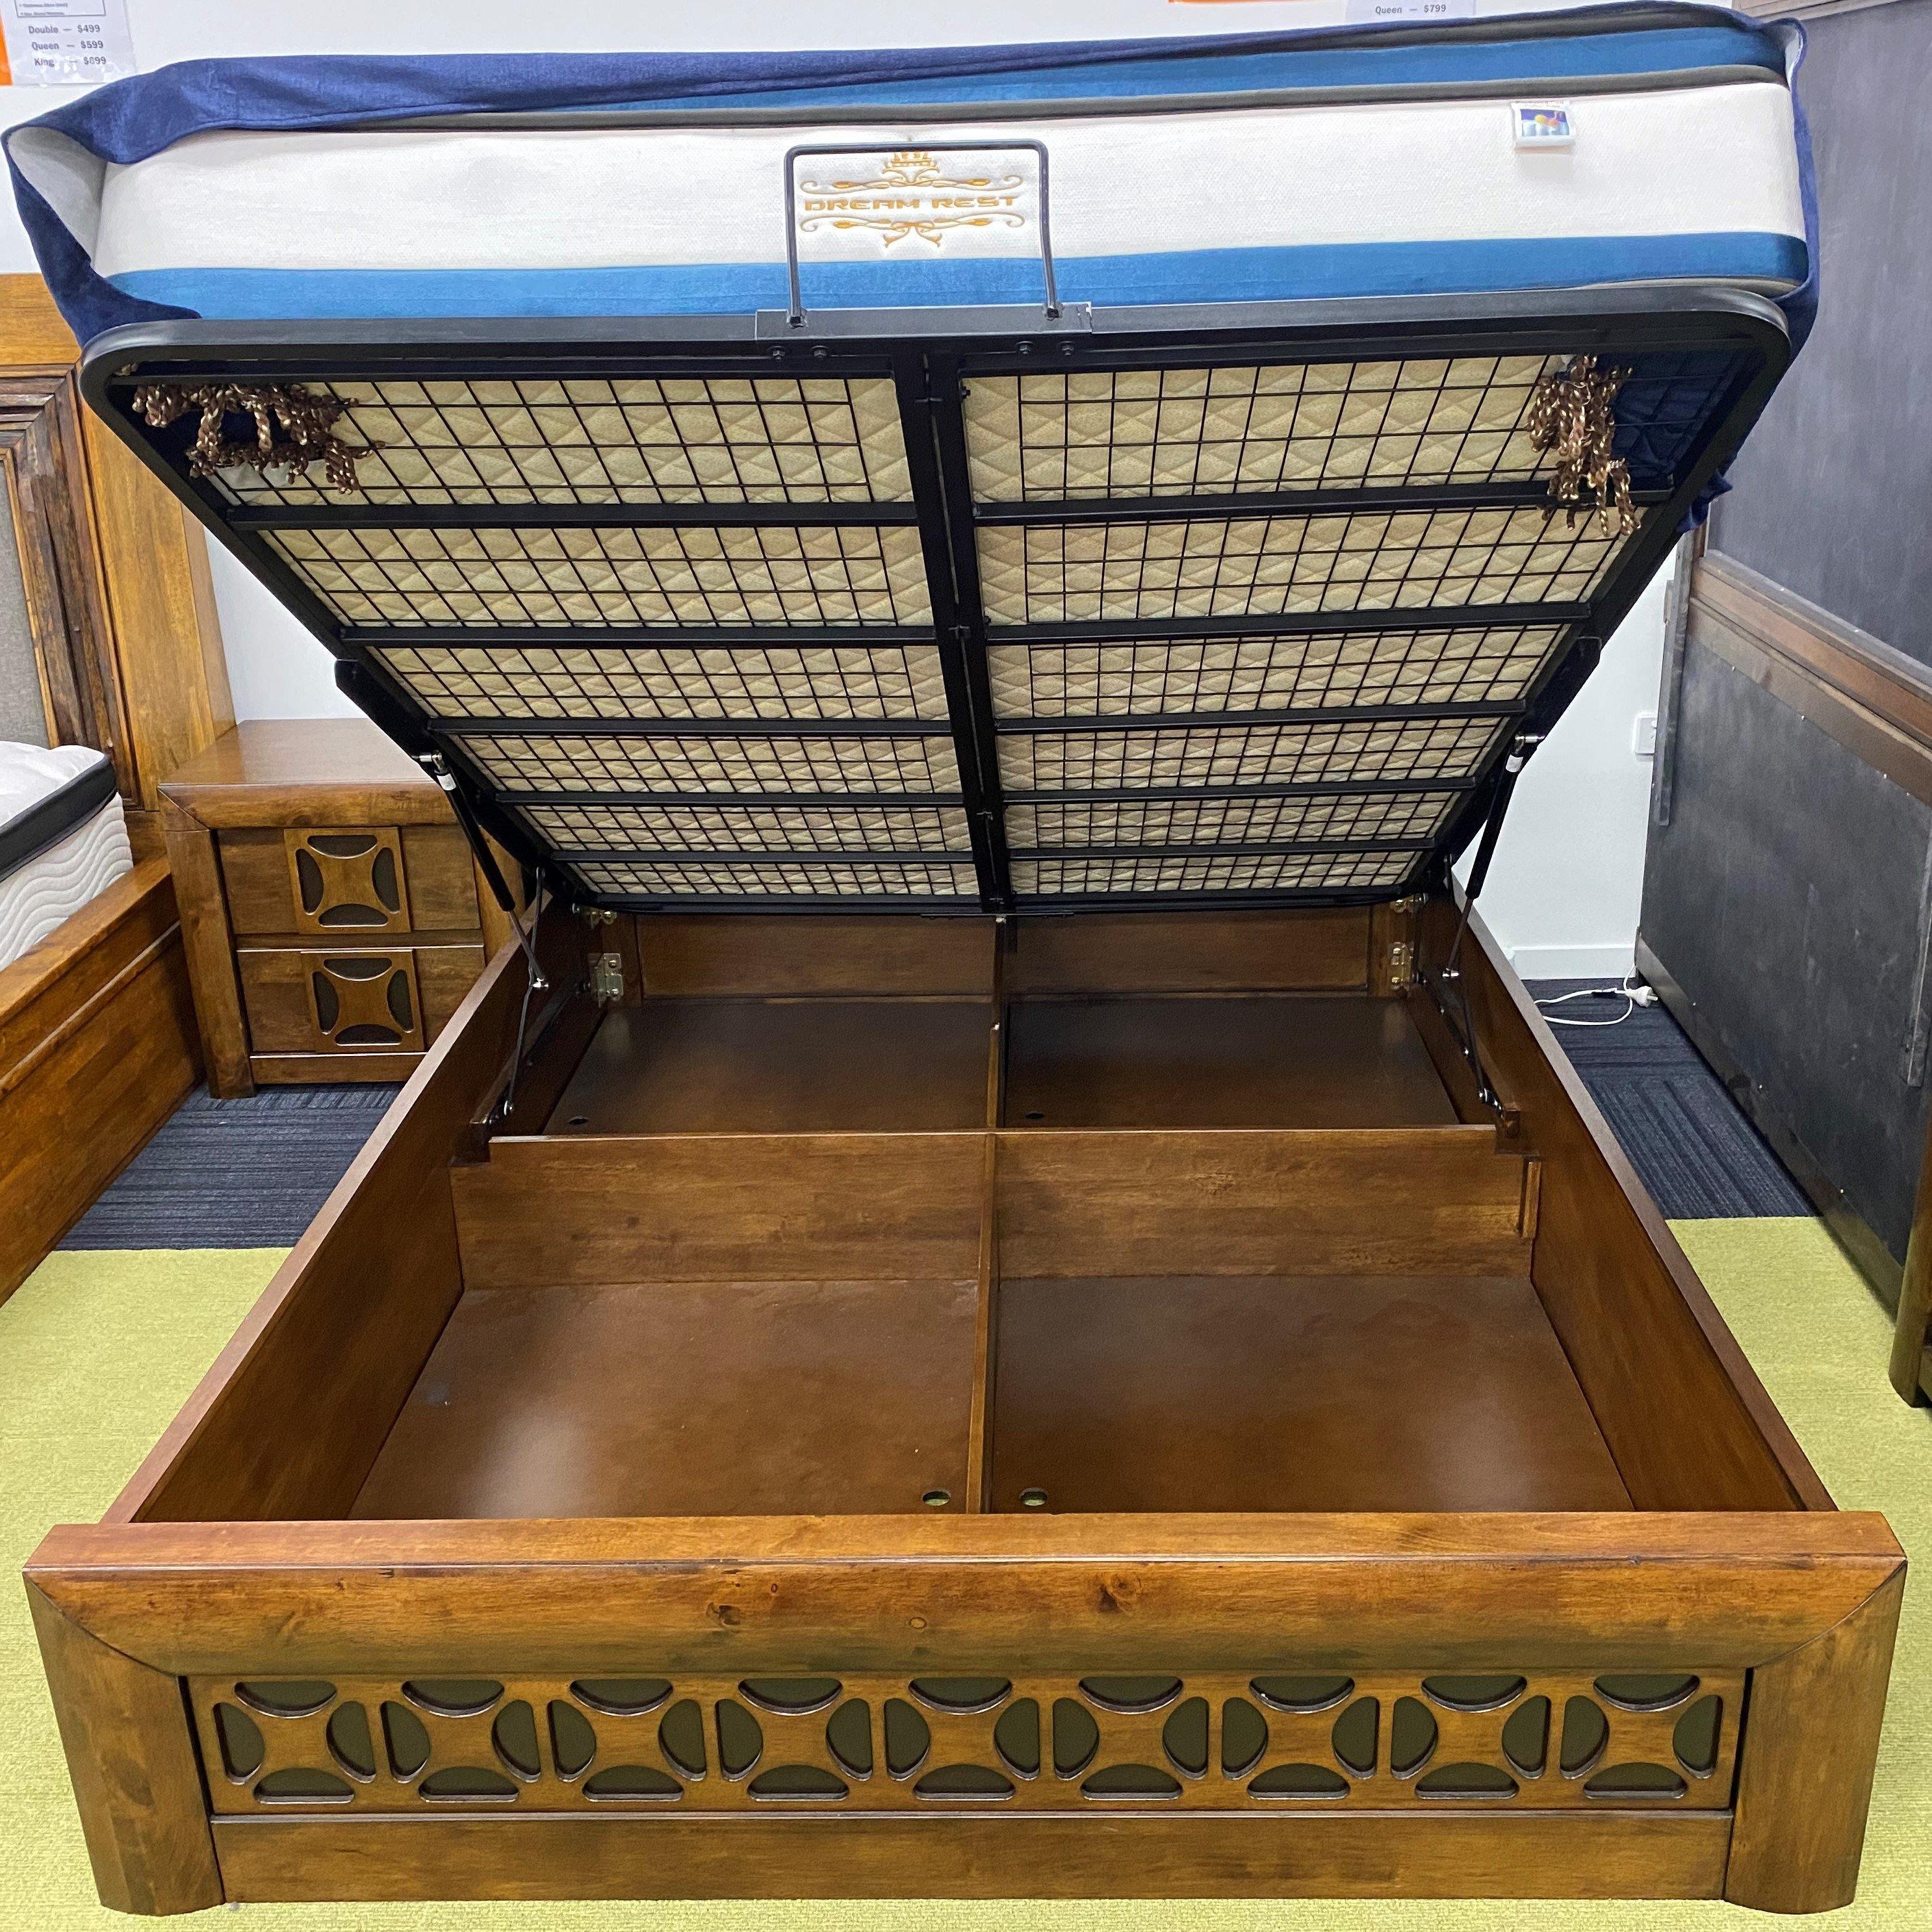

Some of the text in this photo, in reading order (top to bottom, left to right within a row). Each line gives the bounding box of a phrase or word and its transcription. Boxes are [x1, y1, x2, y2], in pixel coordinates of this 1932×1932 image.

[1375, 6, 1402, 14] Queen
[1423, 4, 1447, 13] $799
[77, 24, 101, 32] $499
[31, 41, 60, 50] Queen
[81, 40, 104, 49] $599
[34, 58, 55, 67] King
[805, 196, 1020, 211] DREAM REST
